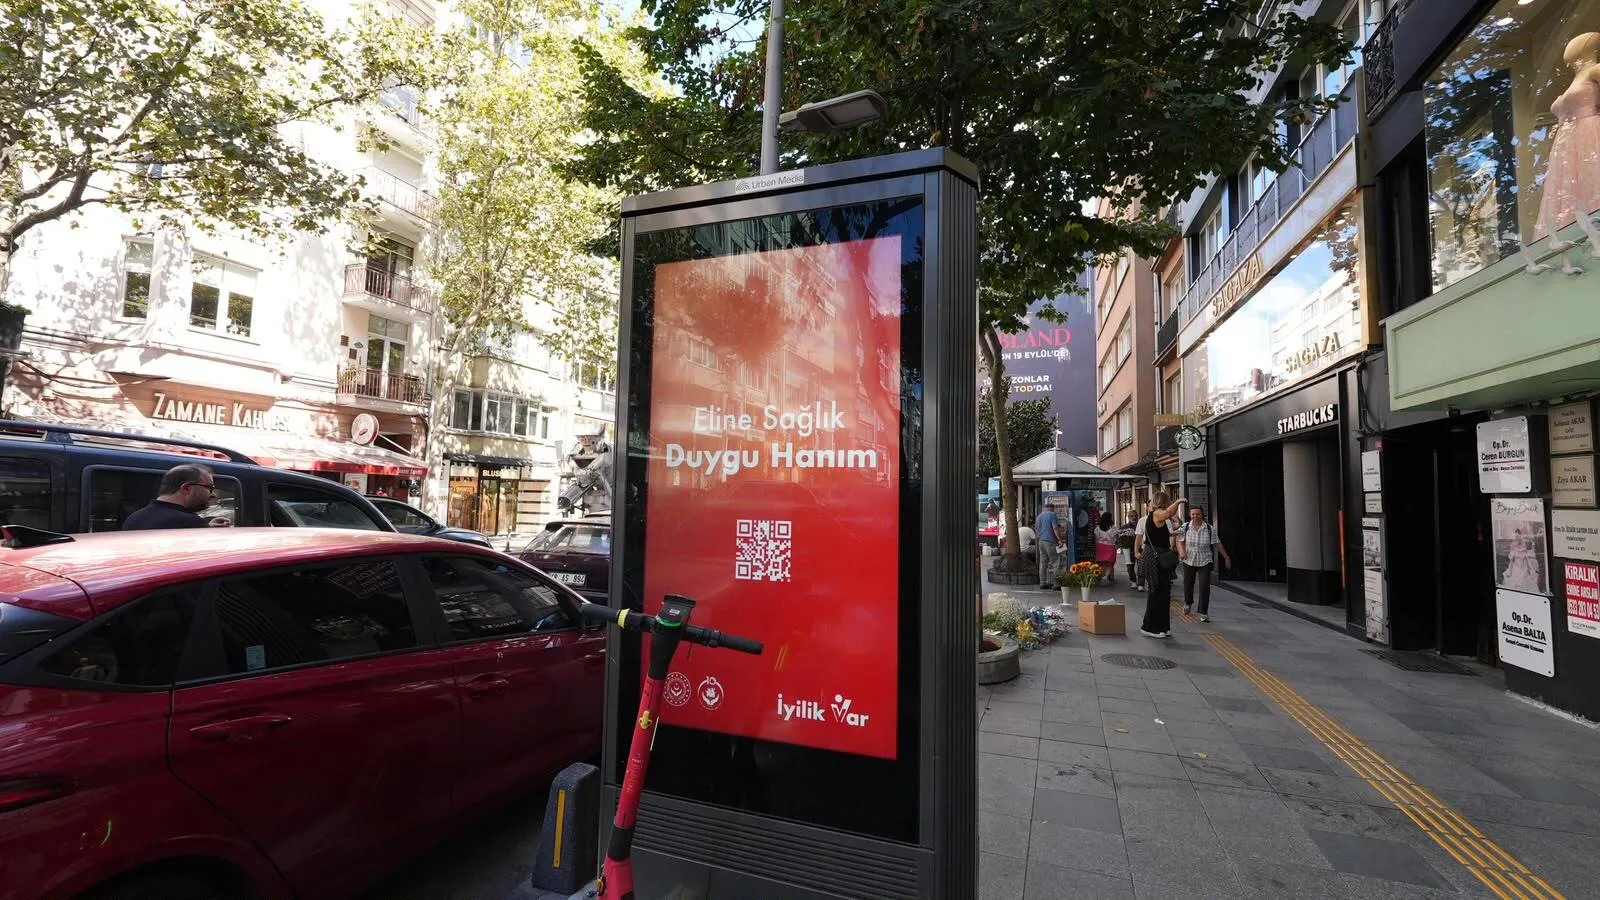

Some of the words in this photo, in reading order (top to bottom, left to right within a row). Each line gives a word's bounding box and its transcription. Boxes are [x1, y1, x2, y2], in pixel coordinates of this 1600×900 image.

[751, 180, 776, 189] Urban
[778, 175, 804, 185] Media
[1212, 252, 1263, 317] SAGAZA
[1013, 352, 1023, 360] 19
[1285, 331, 1341, 373] SAGAZA
[1011, 375, 1050, 384] ZONLAR
[152, 393, 226, 425] ZAMANE
[694, 405, 752, 432] Eline
[763, 401, 846, 437] Sağlık
[1277, 404, 1335, 435] STARBUCKS
[666, 443, 759, 475] Duygu
[771, 442, 877, 468] Hanım
[1502, 621, 1523, 636] Asena
[1523, 627, 1547, 642] BALTA
[1511, 611, 1534, 625] Op.Dr.
[777, 693, 826, 721] İyilik
[830, 694, 870, 727] Var
